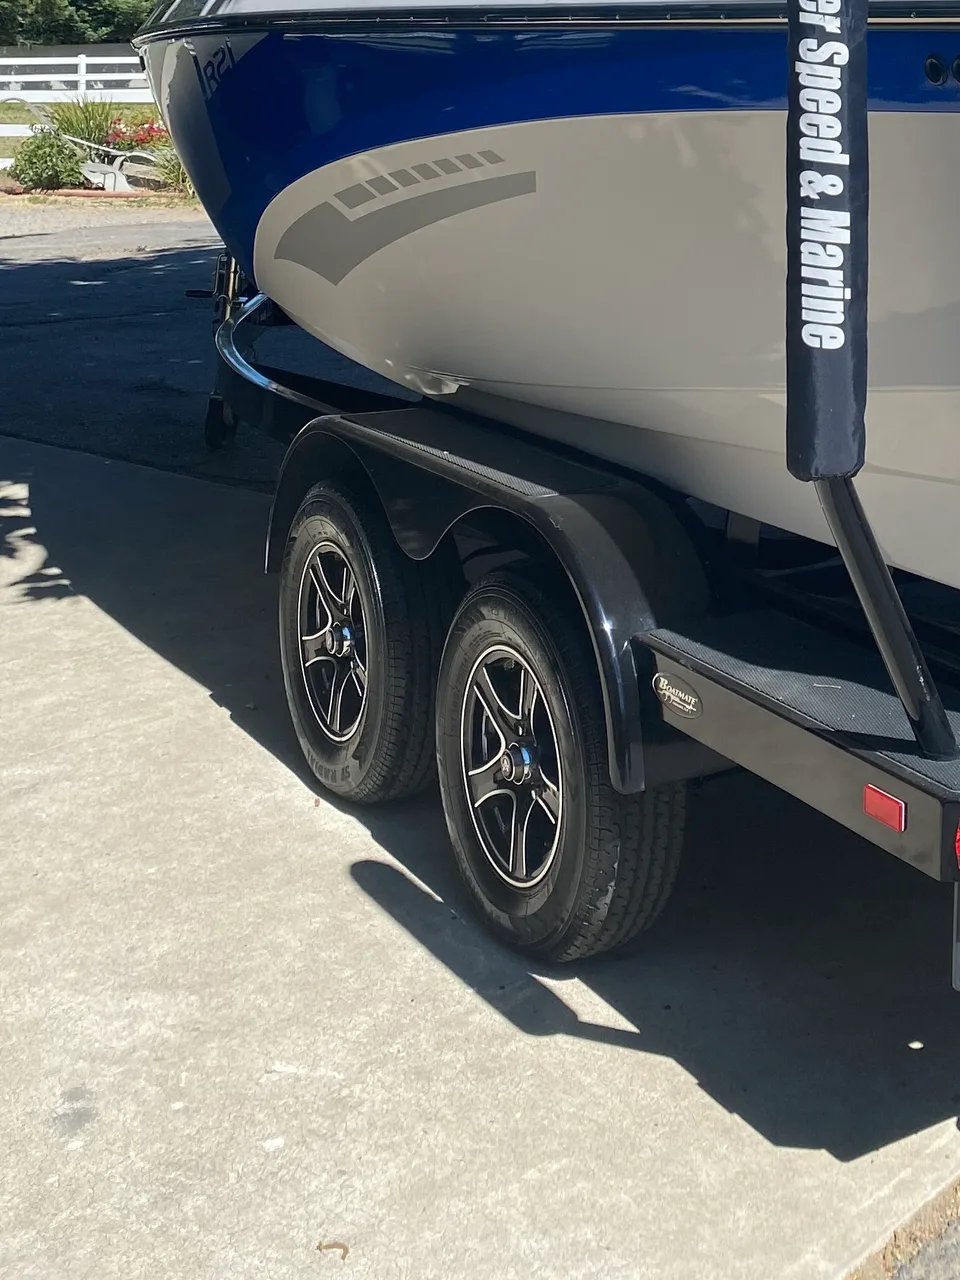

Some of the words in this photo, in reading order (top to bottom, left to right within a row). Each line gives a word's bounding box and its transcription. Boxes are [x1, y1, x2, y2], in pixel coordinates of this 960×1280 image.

[795, 40, 850, 166] Speed
[798, 169, 844, 200] &
[800, 206, 852, 351] Marine
